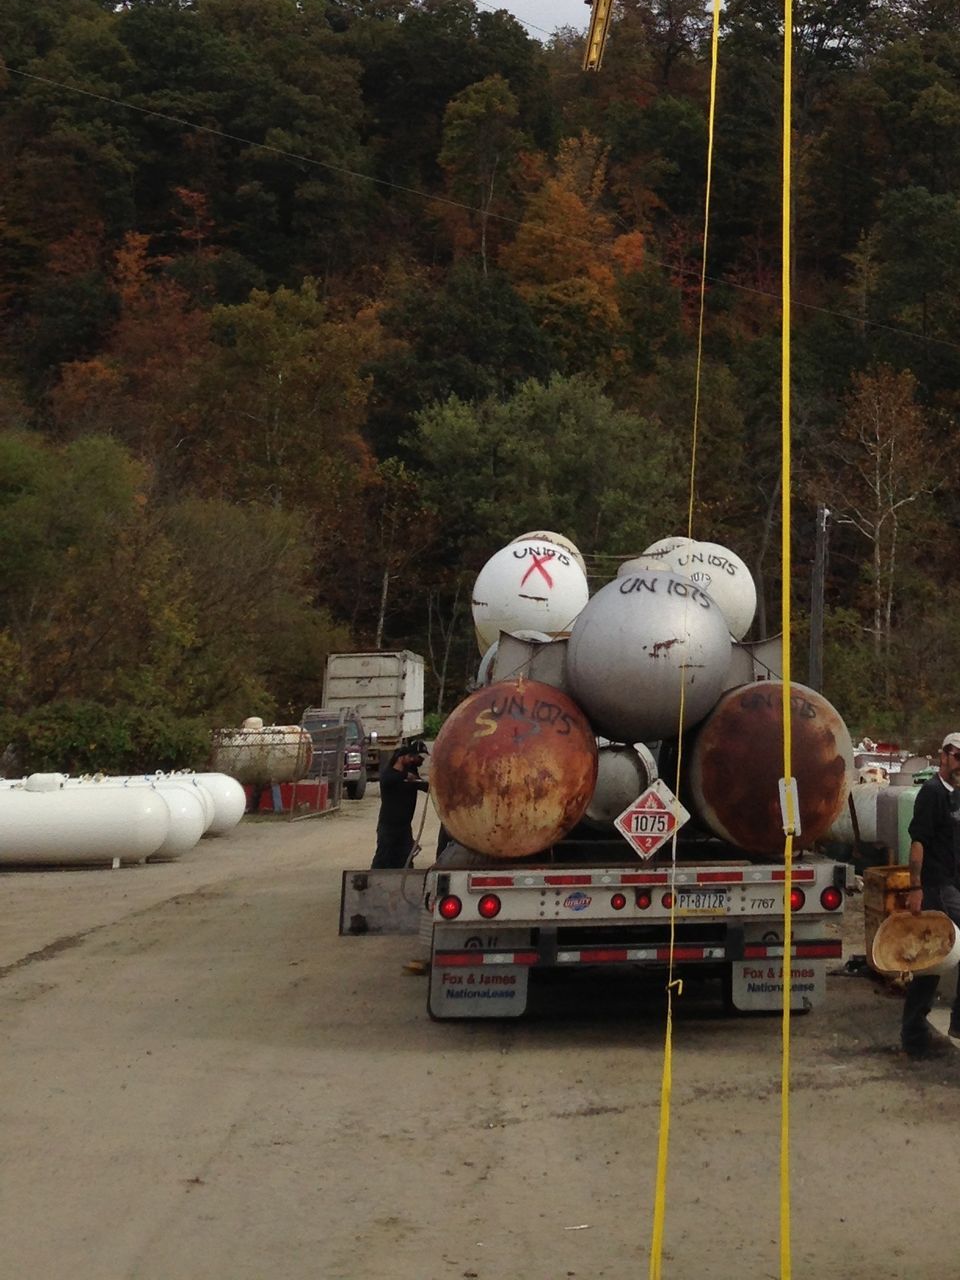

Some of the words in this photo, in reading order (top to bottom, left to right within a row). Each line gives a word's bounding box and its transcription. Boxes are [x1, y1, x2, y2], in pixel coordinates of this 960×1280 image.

[678, 553, 704, 566] UN
[708, 554, 738, 575] 1075
[620, 578, 658, 594] UN
[667, 580, 711, 609] 1075
[634, 815, 665, 832] 1075
[645, 837, 652, 847] 2
[751, 898, 775, 909] 7767
[442, 973, 463, 985] Fox
[467, 972, 475, 984] &
[479, 973, 516, 985] James
[743, 967, 763, 978] Fox
[767, 967, 775, 978] &
[778, 967, 814, 978] Jmes
